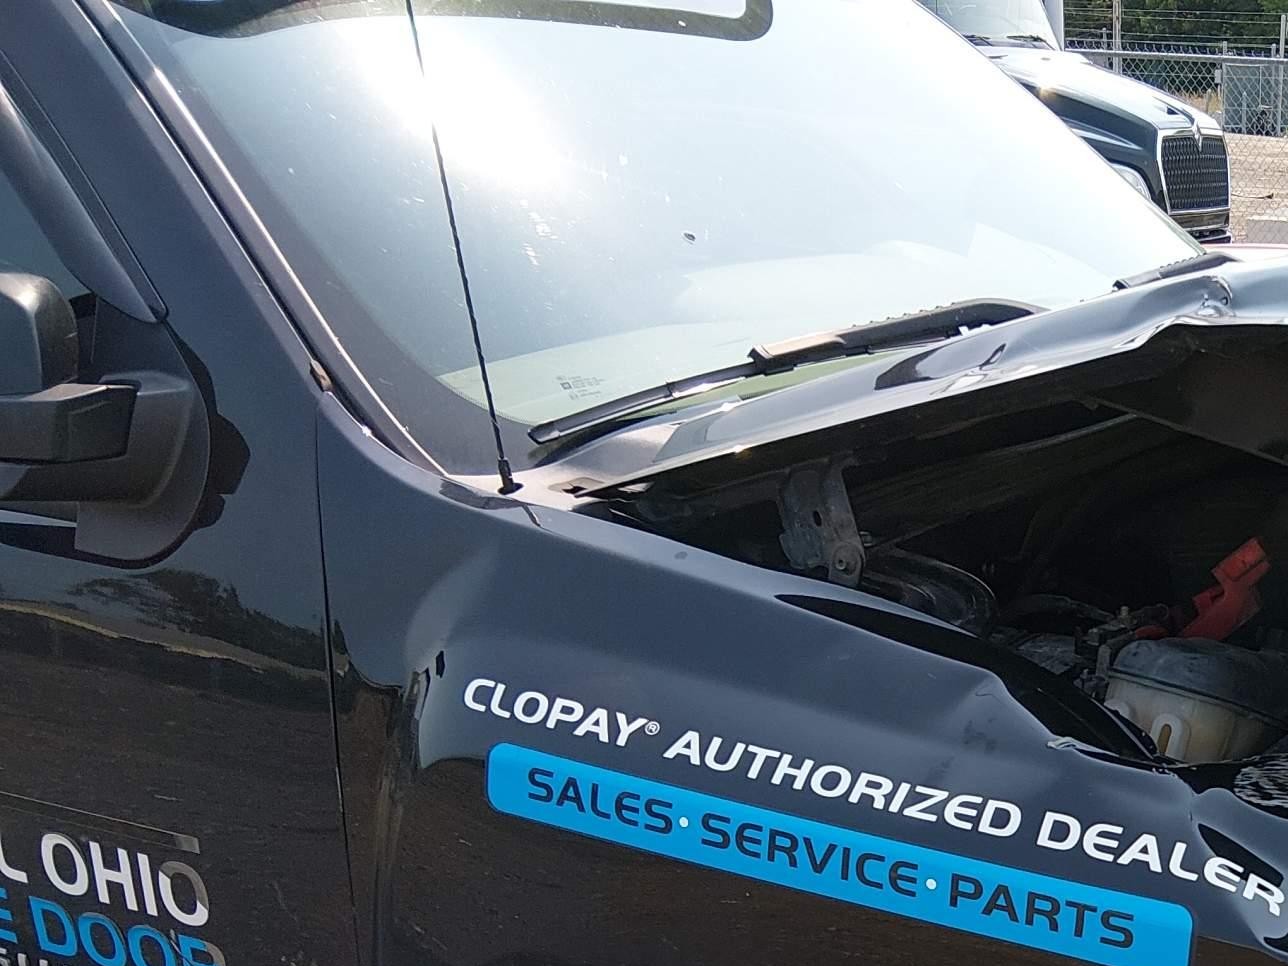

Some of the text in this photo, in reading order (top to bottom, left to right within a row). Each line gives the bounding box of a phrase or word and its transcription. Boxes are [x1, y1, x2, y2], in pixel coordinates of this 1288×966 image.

[40, 832, 209, 926] OHIO
[528, 767, 1135, 949] SALES SERVICE PARTS
[662, 730, 1022, 838] AUTHORIZED
[1036, 811, 1285, 916] DEALER
